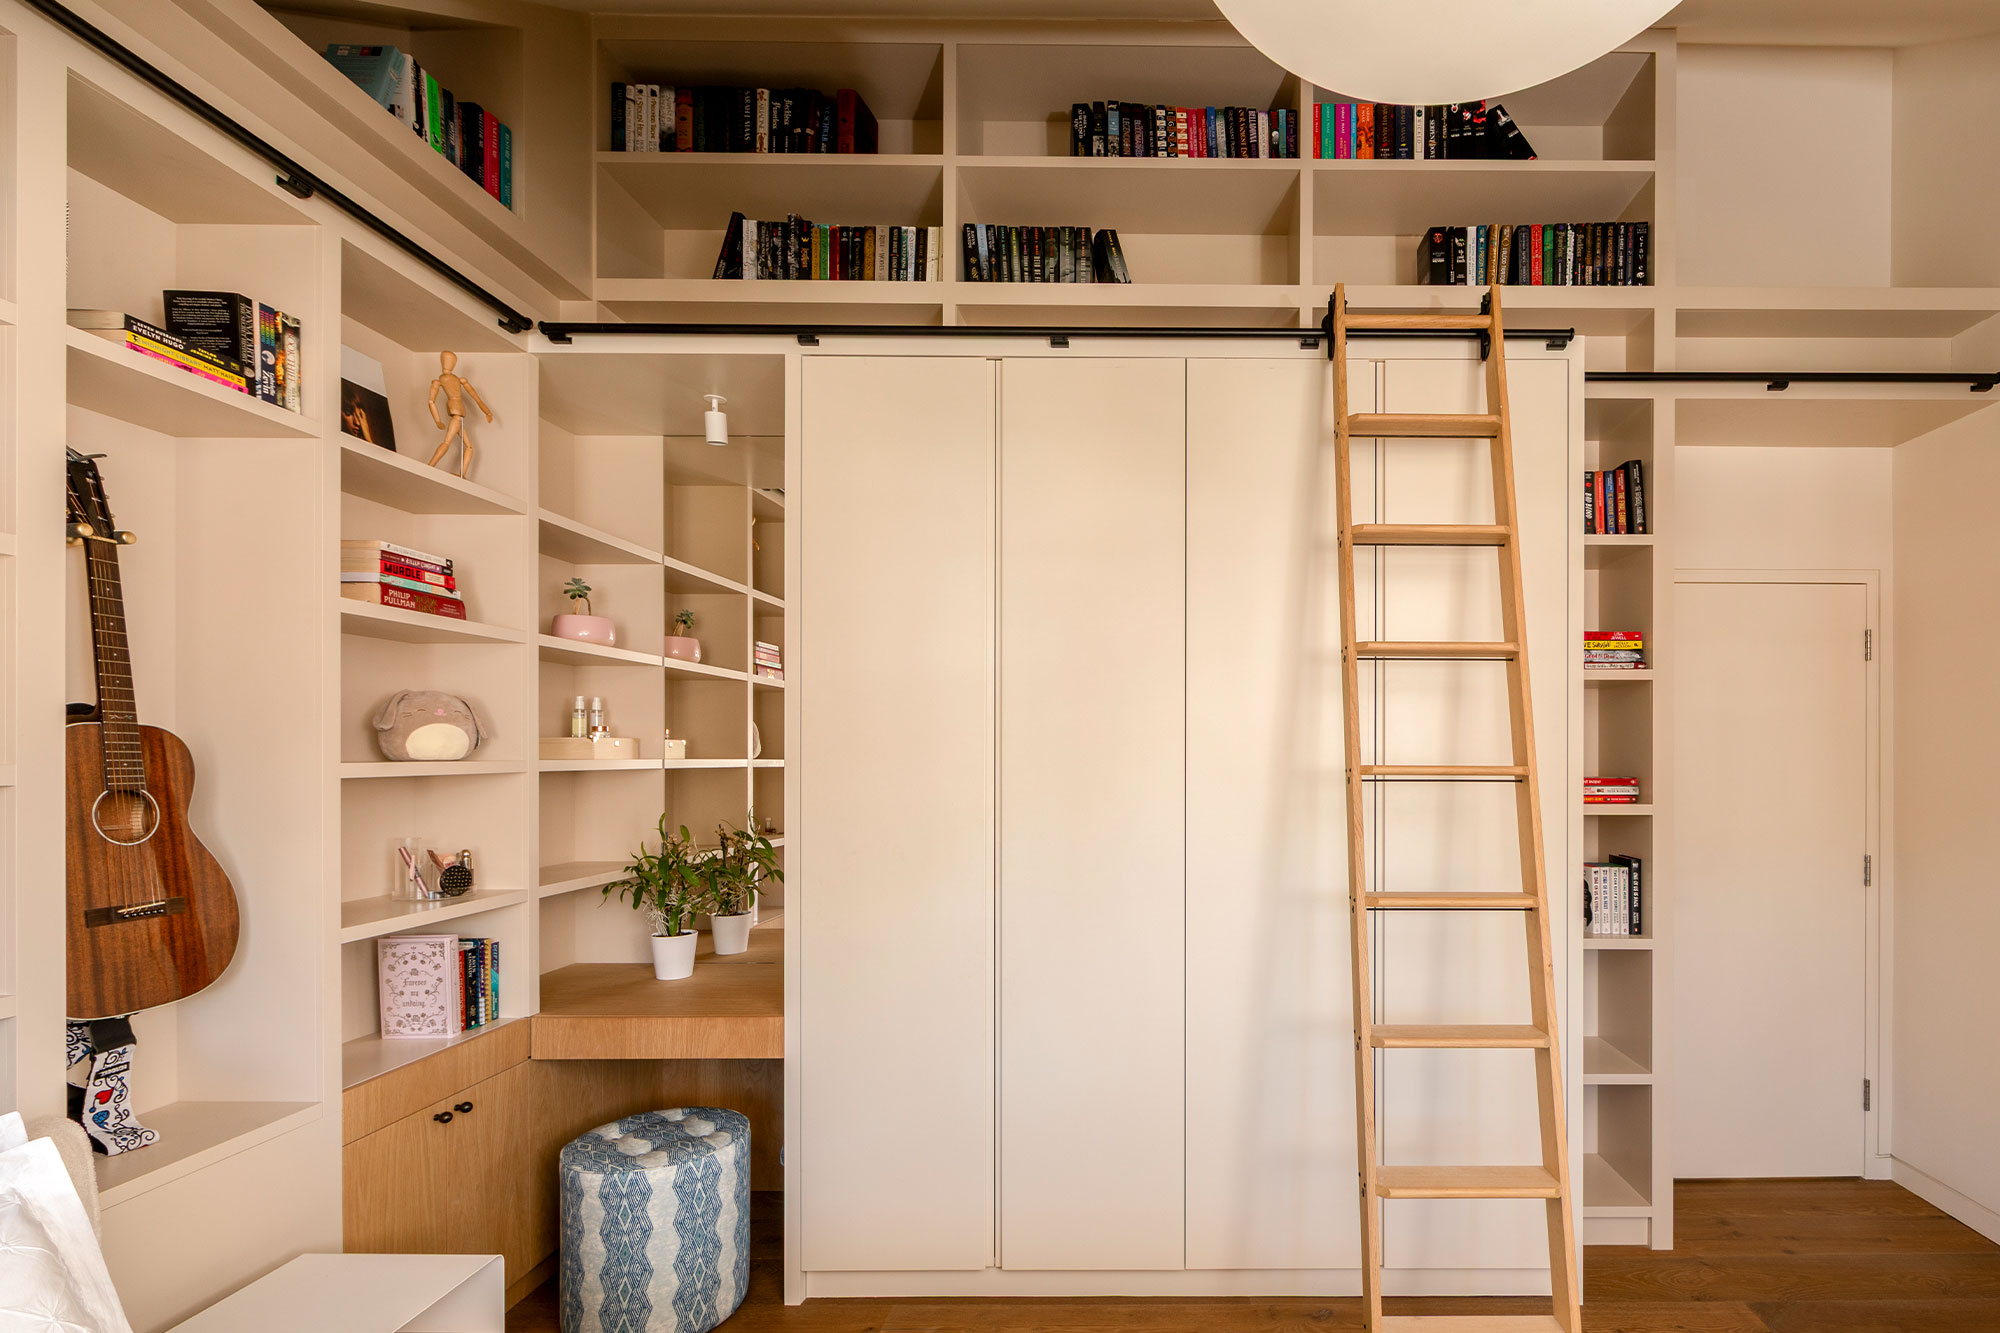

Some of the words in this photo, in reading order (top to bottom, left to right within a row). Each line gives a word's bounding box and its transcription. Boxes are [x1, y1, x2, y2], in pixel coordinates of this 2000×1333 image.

[132, 325, 161, 341] EVELYN
[163, 337, 184, 350] HUGO
[384, 563, 421, 580] MURDLE
[389, 590, 411, 599] PHILIP
[384, 596, 416, 608] PULLMAN
